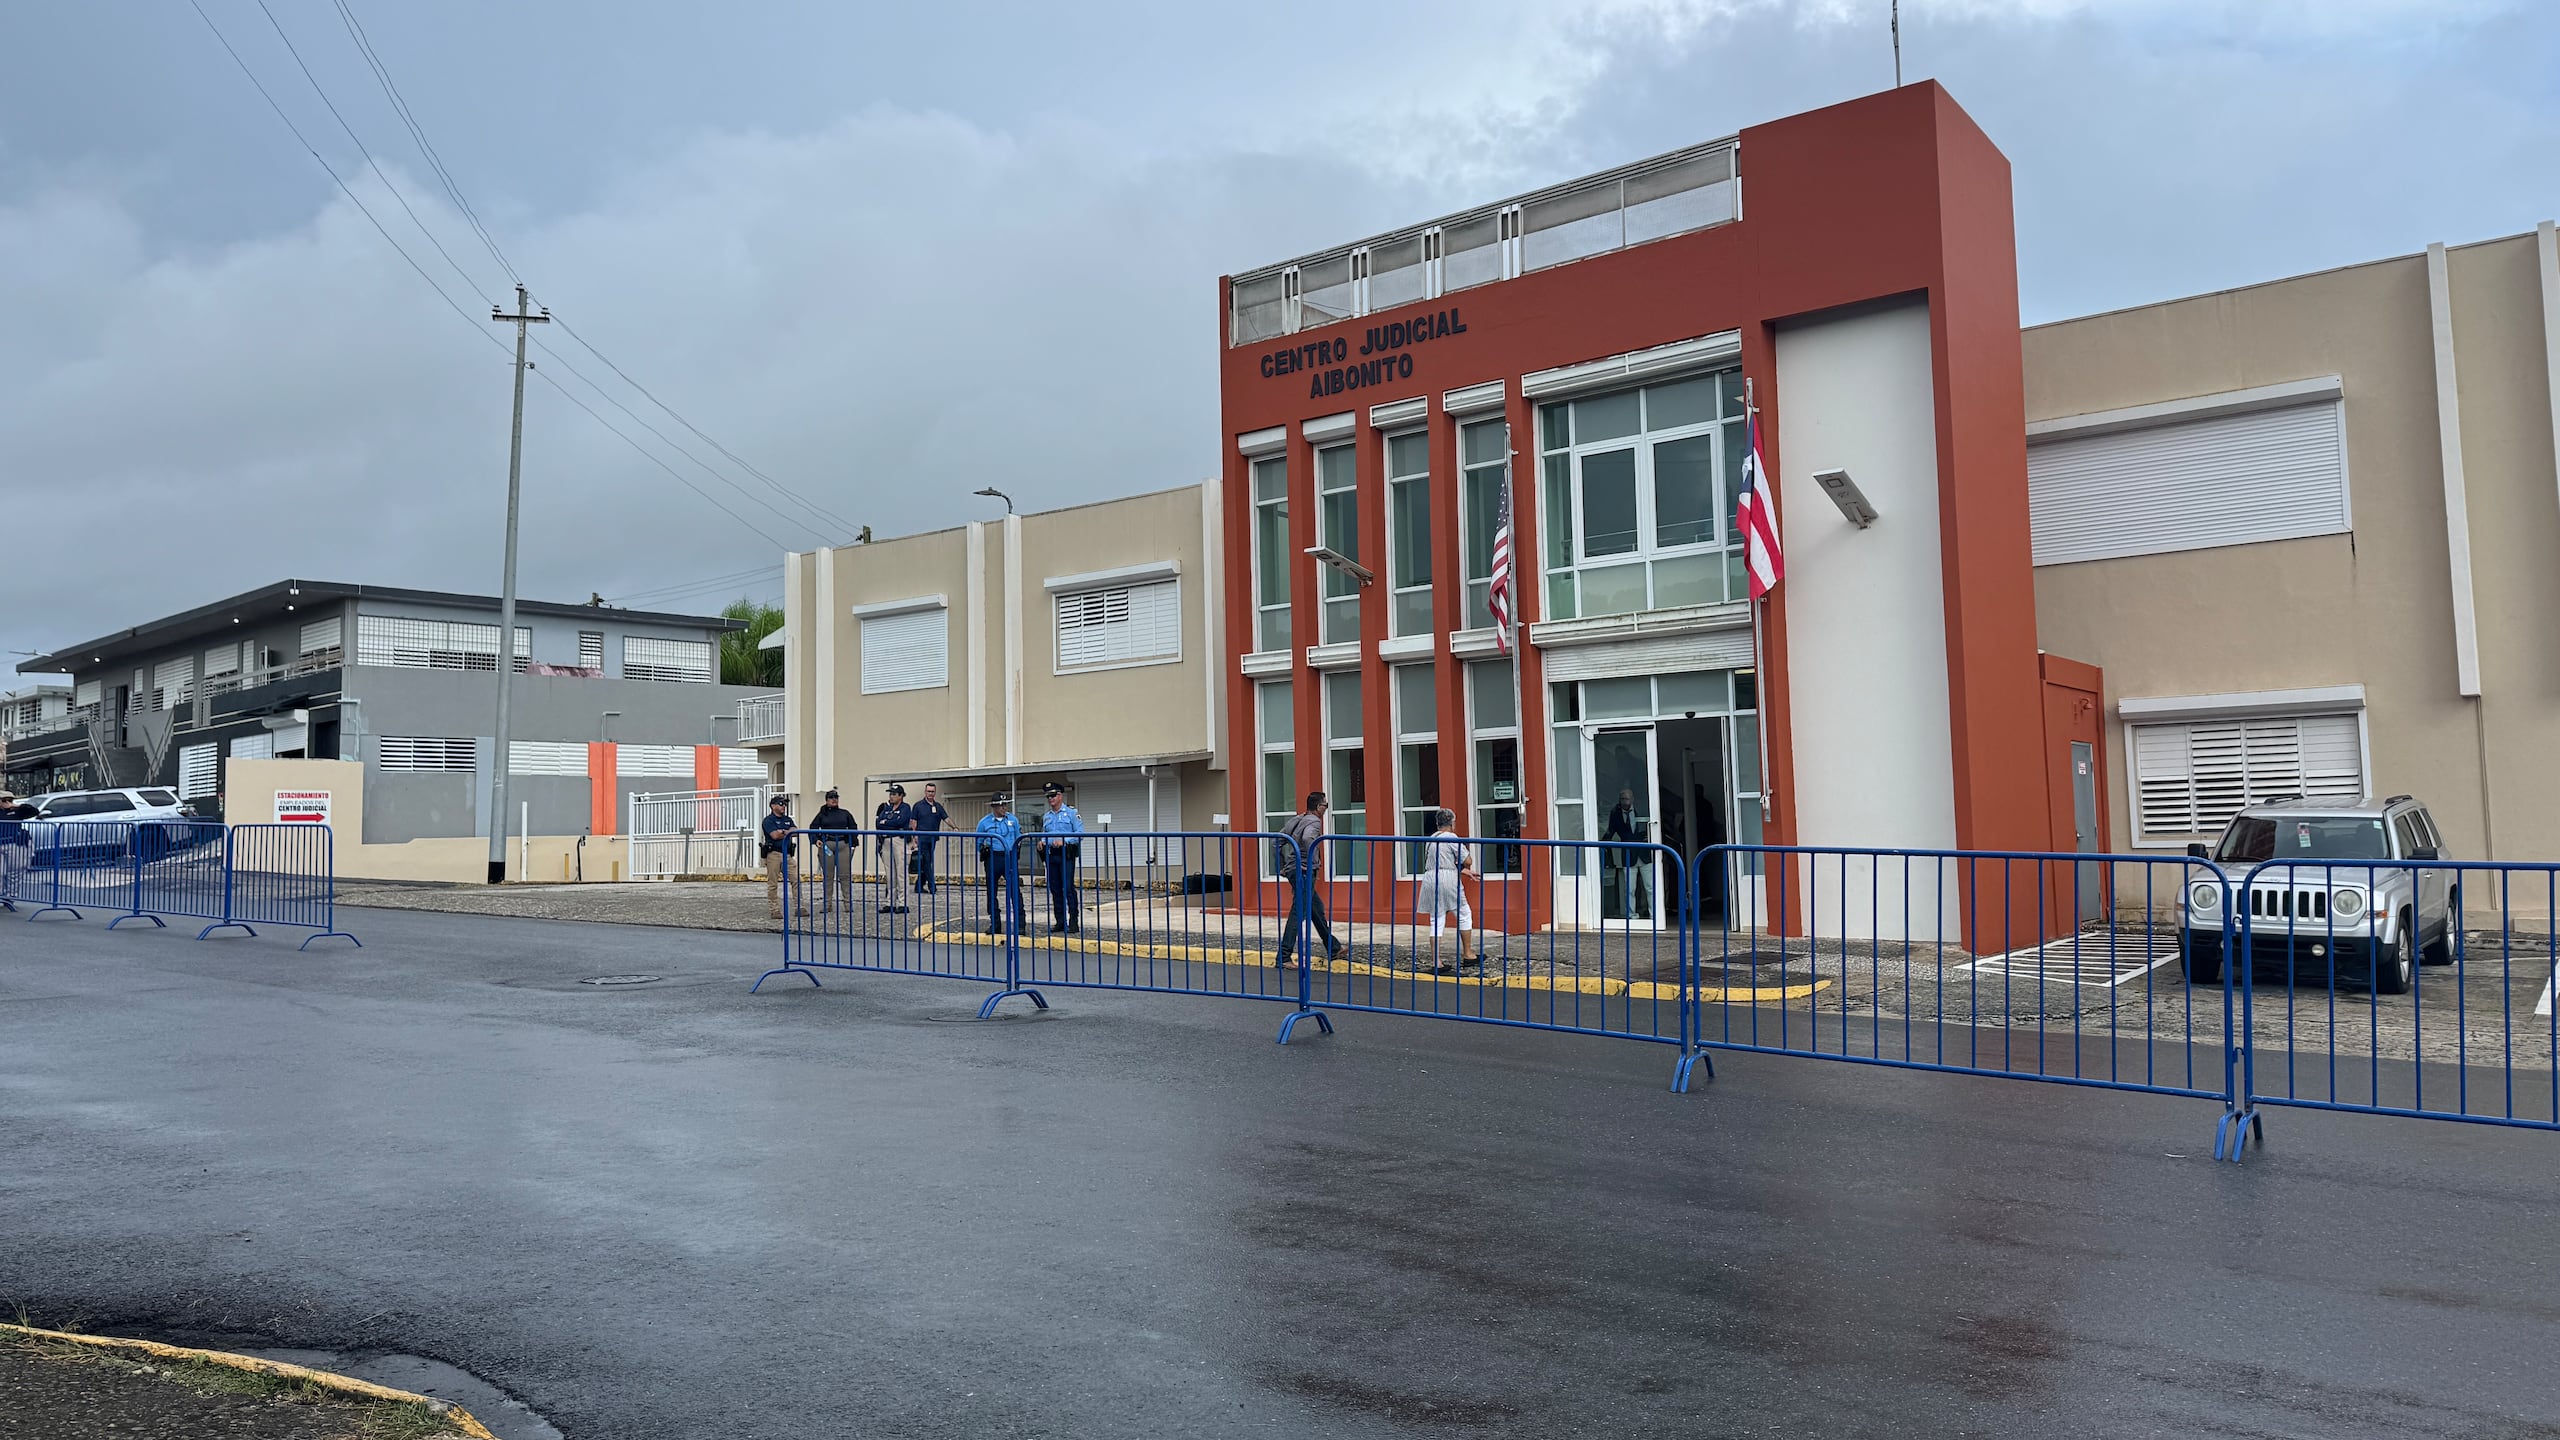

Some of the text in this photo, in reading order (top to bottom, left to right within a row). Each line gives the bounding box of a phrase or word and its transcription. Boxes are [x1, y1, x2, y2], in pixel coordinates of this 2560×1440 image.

[1260, 308, 1467, 378] CENTRO JUDICIAL
[1310, 353, 1413, 398] AIBONITO
